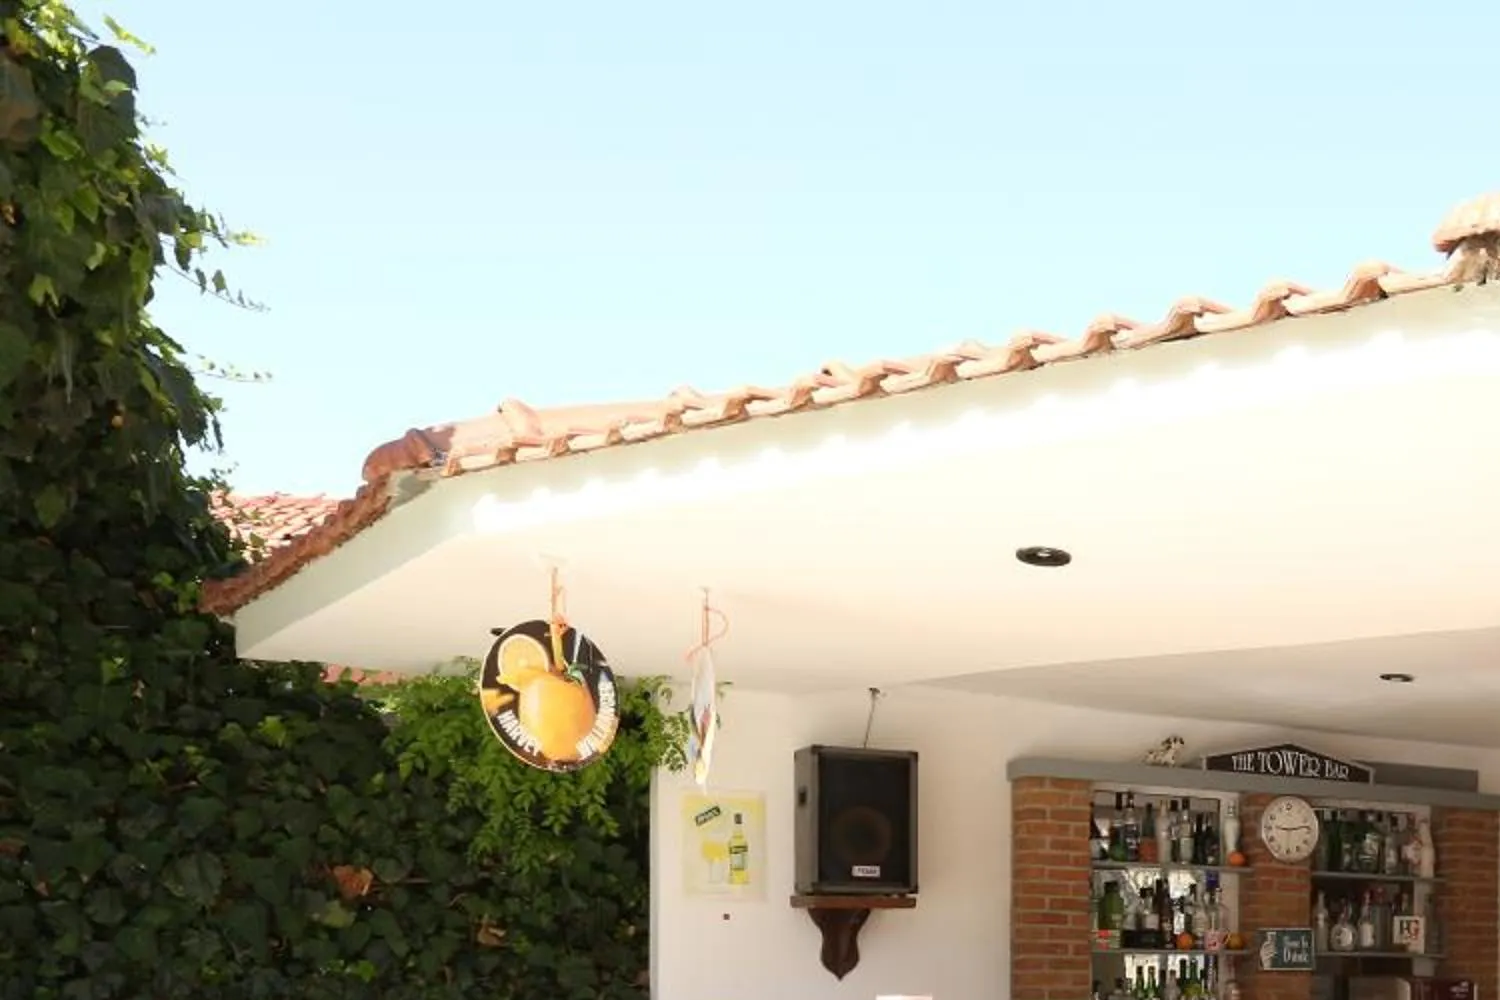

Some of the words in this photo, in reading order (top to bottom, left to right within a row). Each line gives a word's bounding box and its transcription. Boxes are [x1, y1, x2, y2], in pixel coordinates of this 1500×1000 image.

[497, 709, 543, 756] HARVEY
[1231, 752, 1255, 772] THE
[1257, 749, 1321, 778] TOWER
[1323, 759, 1349, 780] BAR
